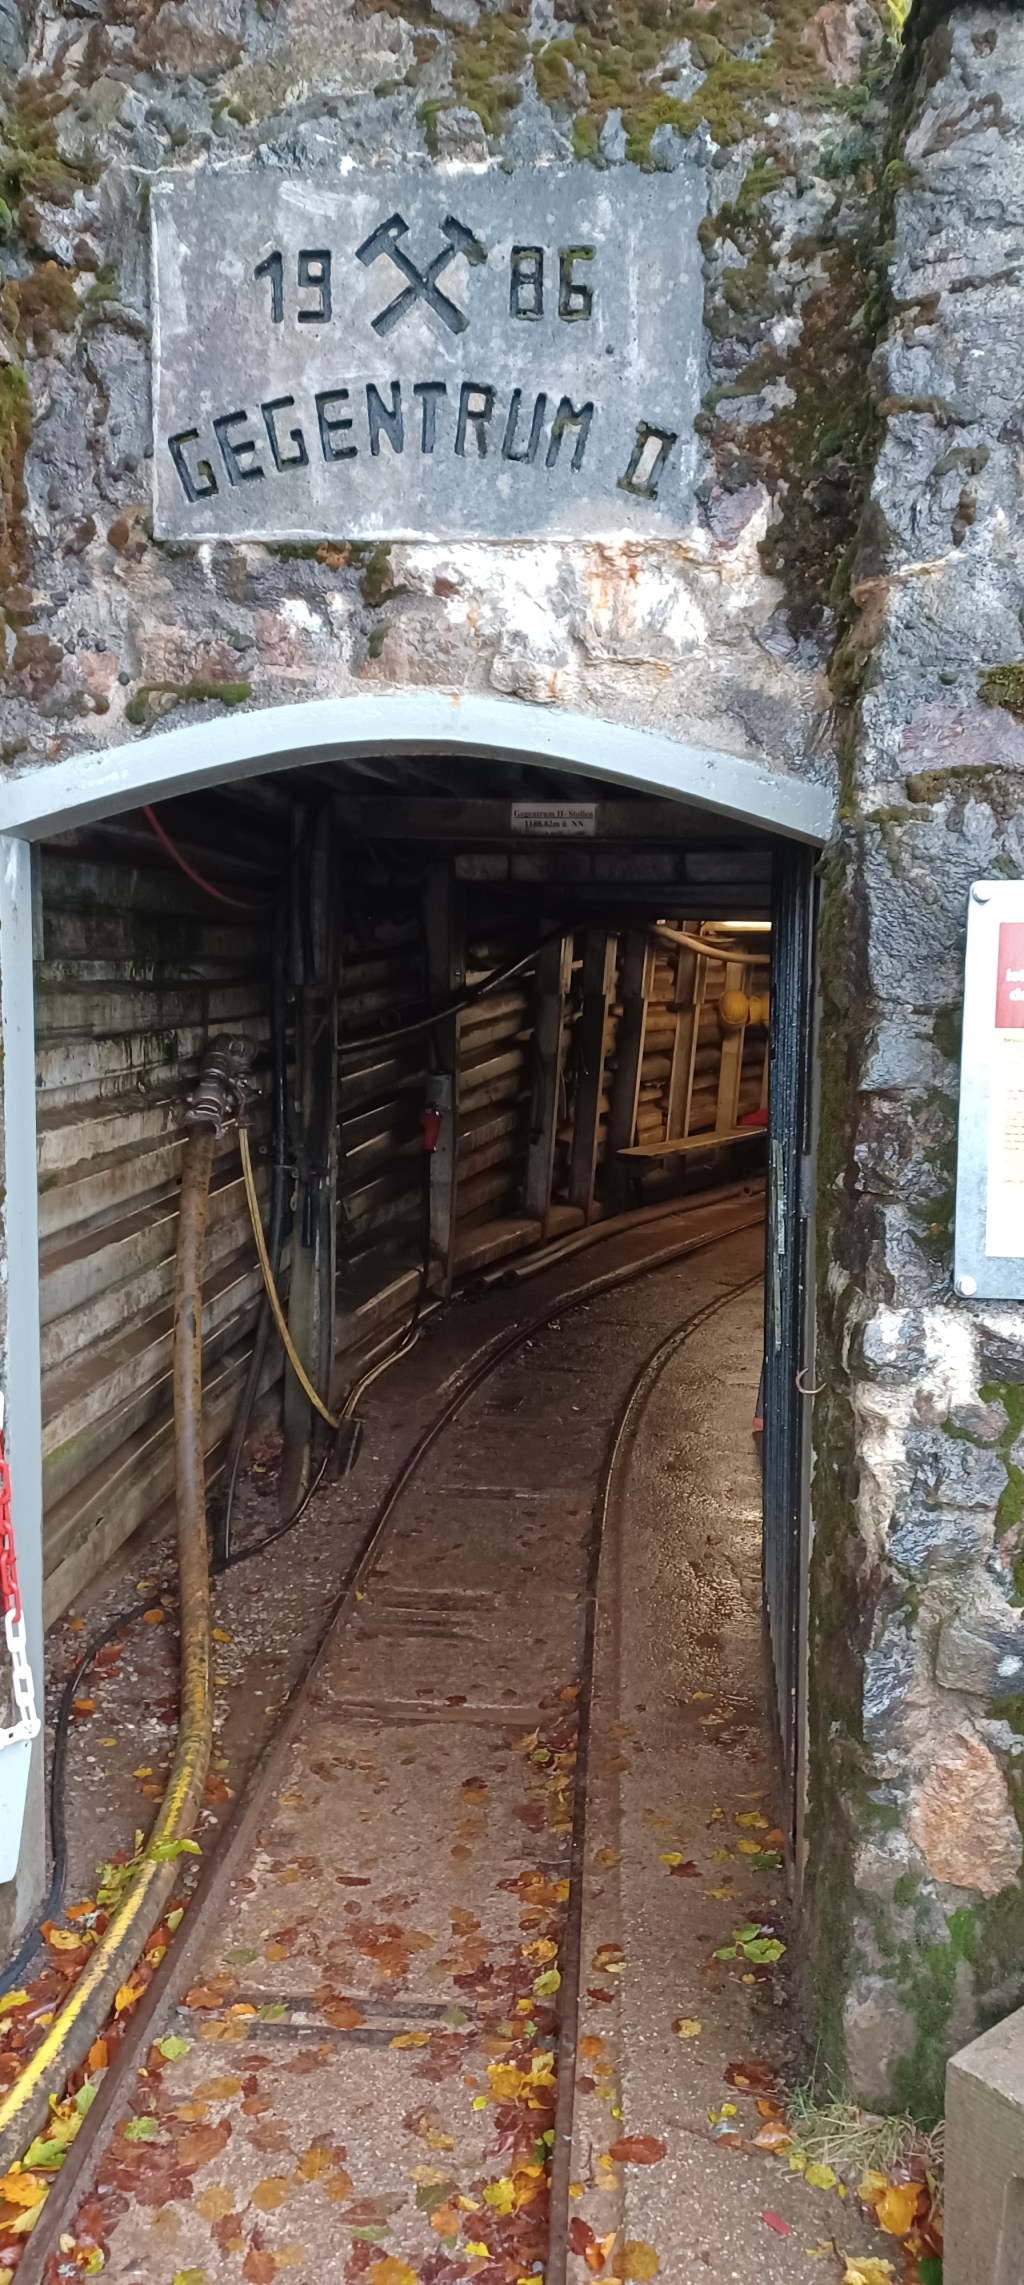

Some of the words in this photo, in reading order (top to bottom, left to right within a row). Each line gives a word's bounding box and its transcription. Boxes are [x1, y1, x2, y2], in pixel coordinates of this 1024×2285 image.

[254, 248, 332, 324] 19
[510, 244, 598, 322] 86
[168, 380, 594, 503] GEGENTRUM
[514, 810, 555, 818] Gegentrum
[568, 810, 594, 818] Stollen
[572, 819, 584, 827] NN
